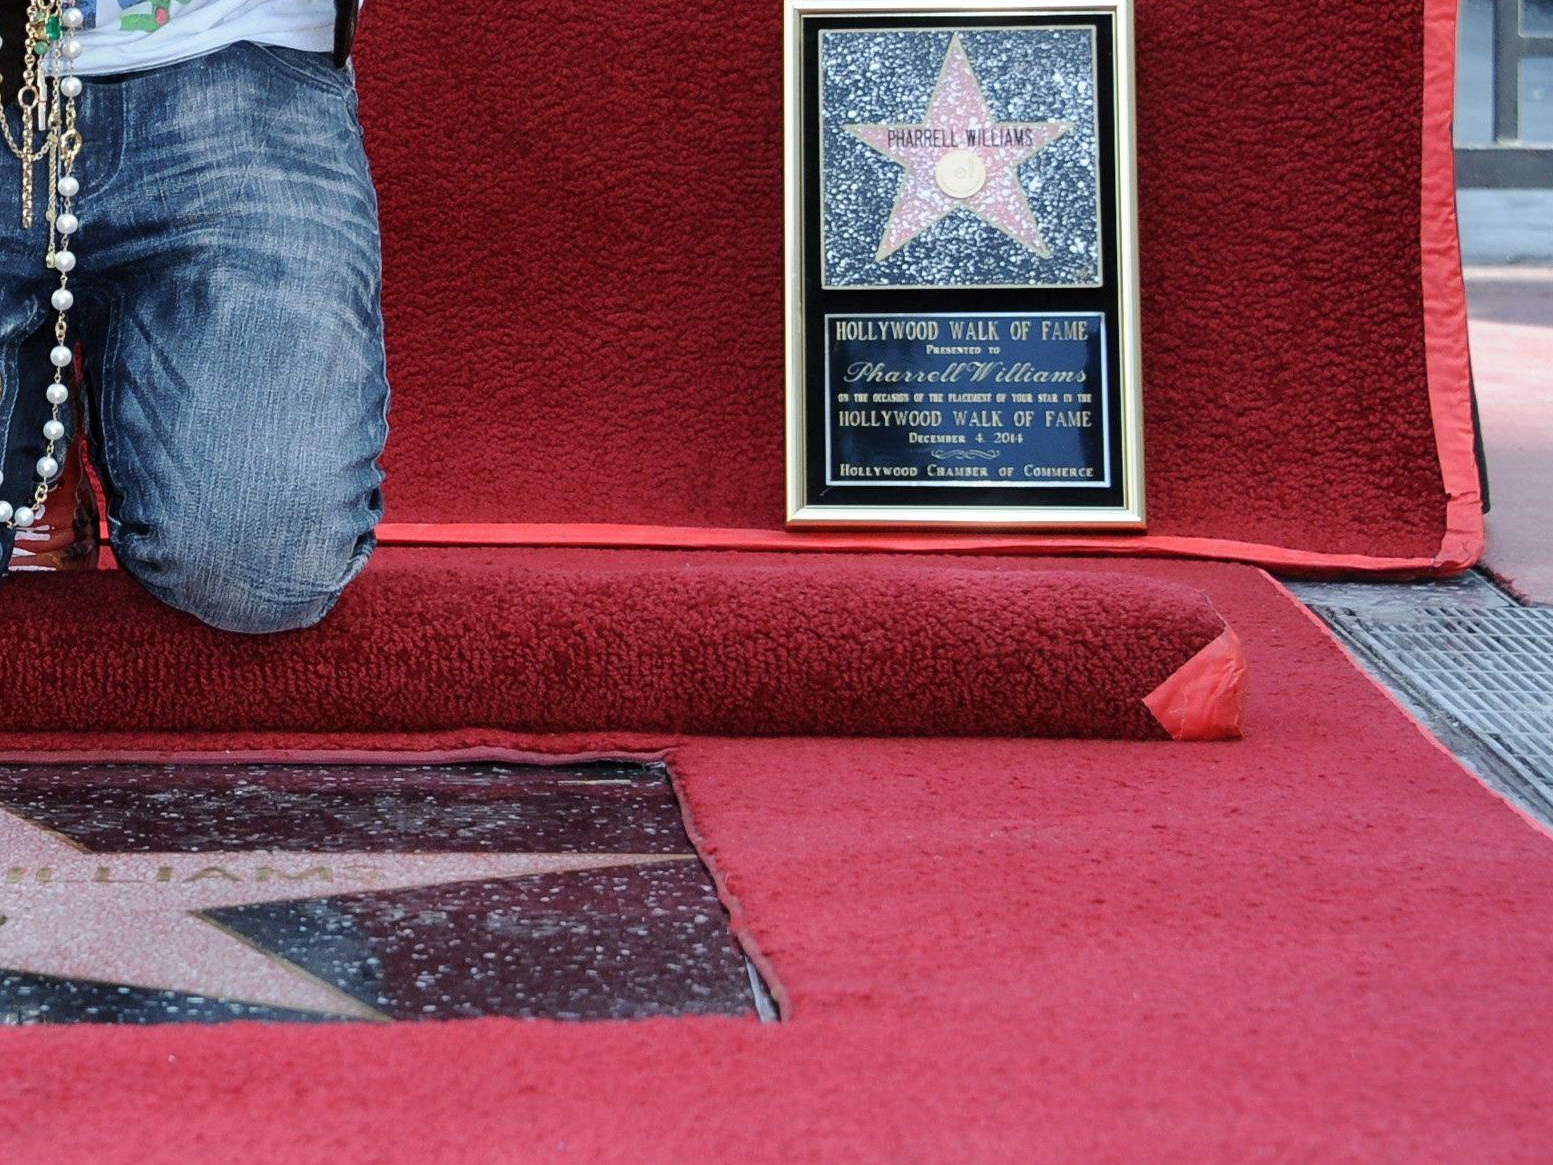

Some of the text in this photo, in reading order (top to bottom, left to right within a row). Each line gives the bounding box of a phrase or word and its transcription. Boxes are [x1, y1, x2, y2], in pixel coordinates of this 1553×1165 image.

[887, 128, 1033, 148] PHARRELL WILLIAMS
[836, 321, 1088, 341] HOLLYWOOD WALK OF FAME
[843, 361, 1087, 383] Pharrell Williams
[1037, 393, 1058, 403] STAR
[838, 410, 1092, 427] HOLLYWOOD WALK OF FAME
[993, 432, 1024, 444] 2014
